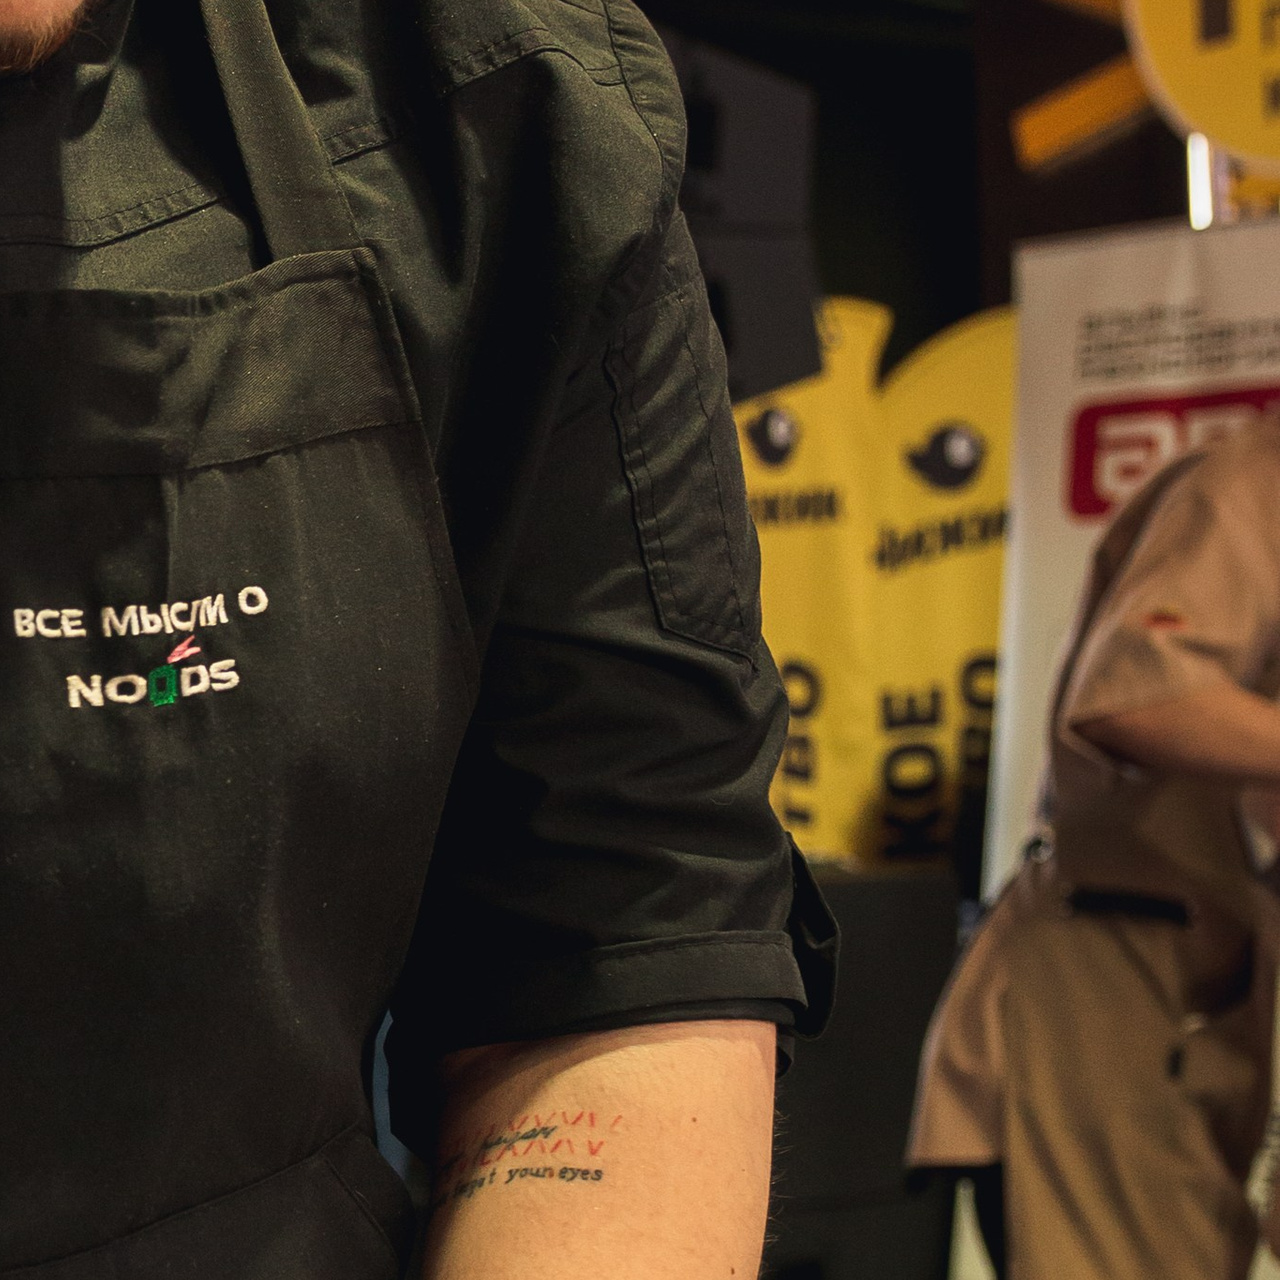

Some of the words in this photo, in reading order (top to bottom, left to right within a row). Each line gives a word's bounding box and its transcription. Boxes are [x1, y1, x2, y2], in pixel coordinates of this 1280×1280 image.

[13, 608, 87, 638] ВСЕ
[101, 593, 229, 637] МЫСЛИ
[237, 585, 269, 615] О
[66, 659, 240, 708] NOODS
[558, 1166, 604, 1182] eyes
